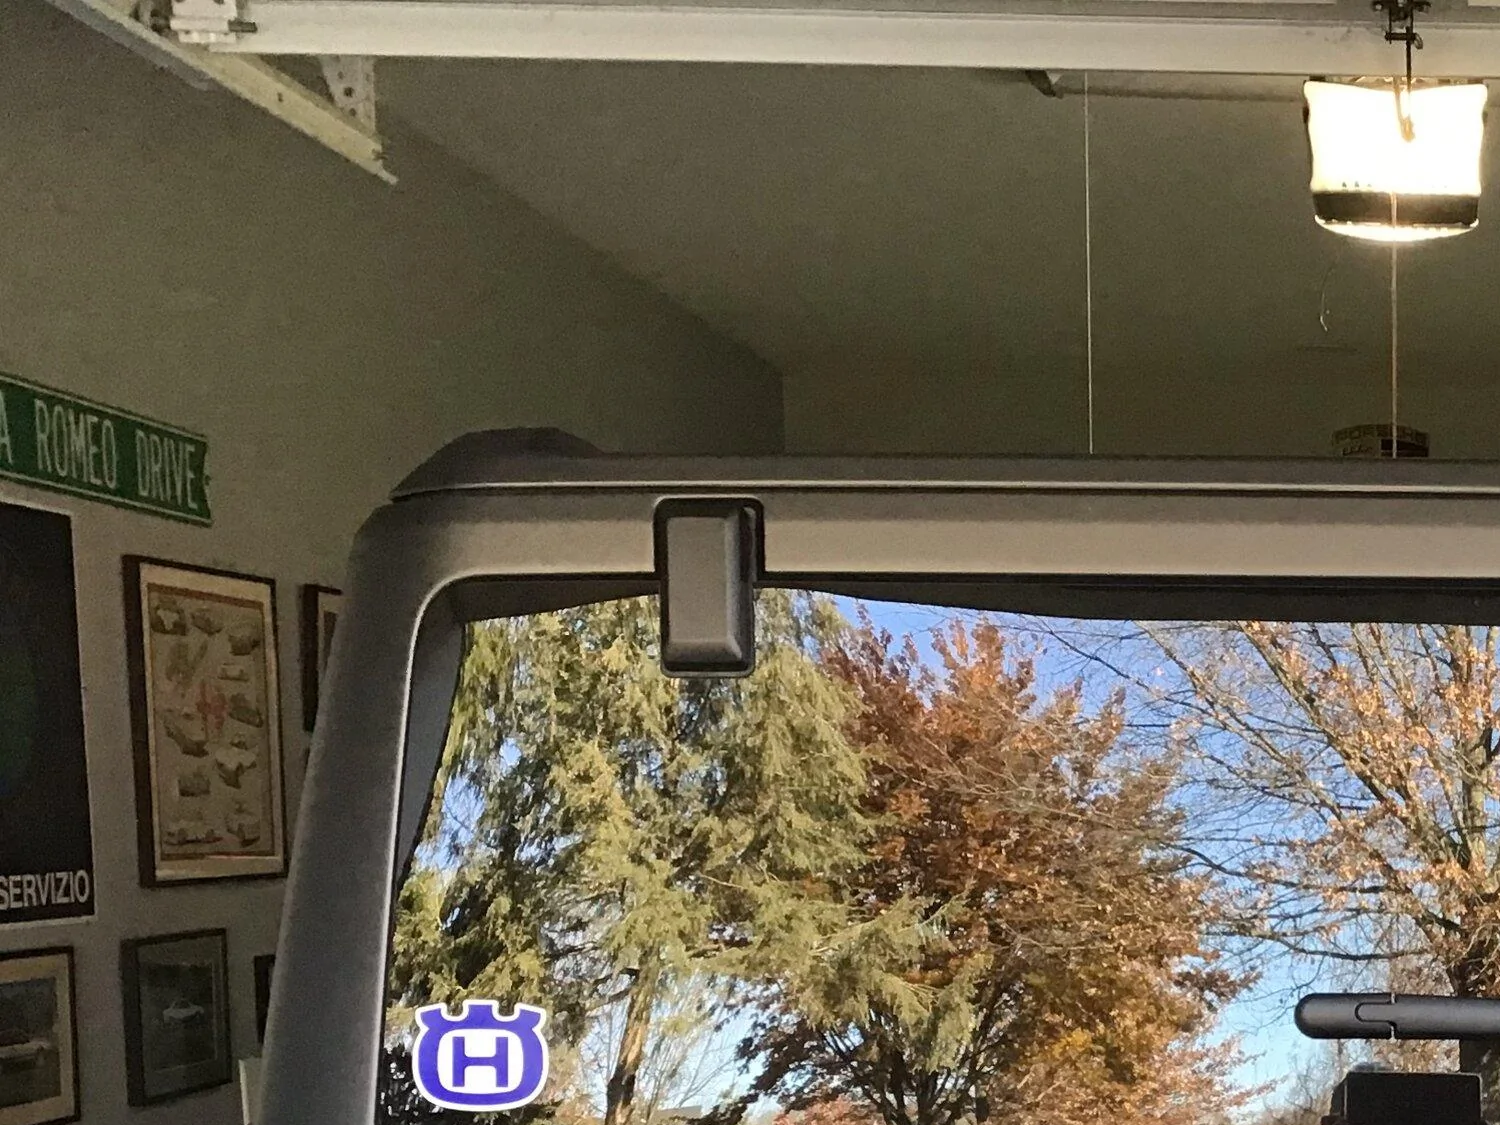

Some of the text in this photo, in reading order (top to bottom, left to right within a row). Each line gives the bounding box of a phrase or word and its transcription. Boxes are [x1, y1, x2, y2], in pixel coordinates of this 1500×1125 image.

[35, 399, 117, 489] ROMEO
[136, 429, 198, 509] DRIVE
[0, 870, 90, 910] SERVIZIO
[452, 1036, 509, 1088] H
